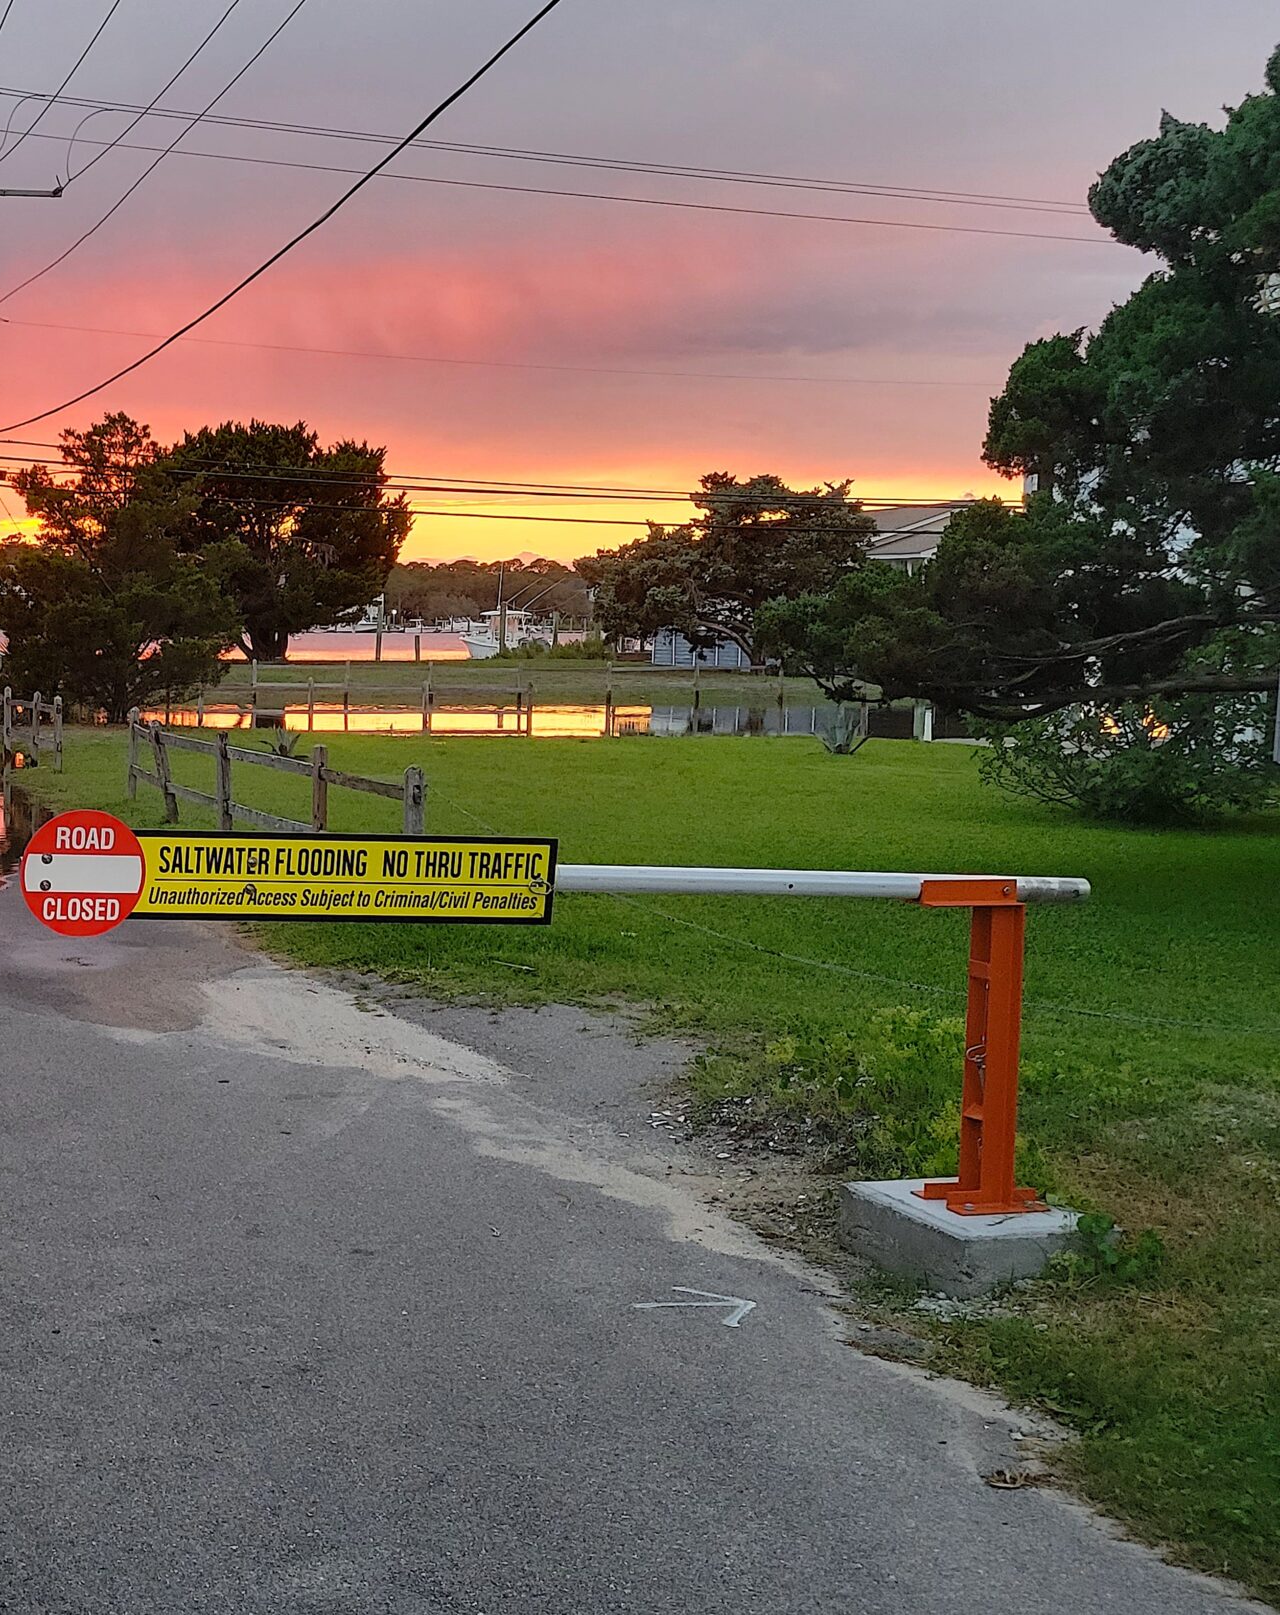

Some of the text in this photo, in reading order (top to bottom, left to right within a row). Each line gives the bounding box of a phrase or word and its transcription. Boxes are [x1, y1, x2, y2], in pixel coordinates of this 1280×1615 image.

[56, 826, 115, 850] ROAD
[159, 846, 542, 880] SALTWATER FLOODING NO THRU TRAFFIC
[42, 897, 120, 921] CLOSED
[148, 886, 538, 910] Unauthorized Access Subject to Criminal/Civil Penalties
